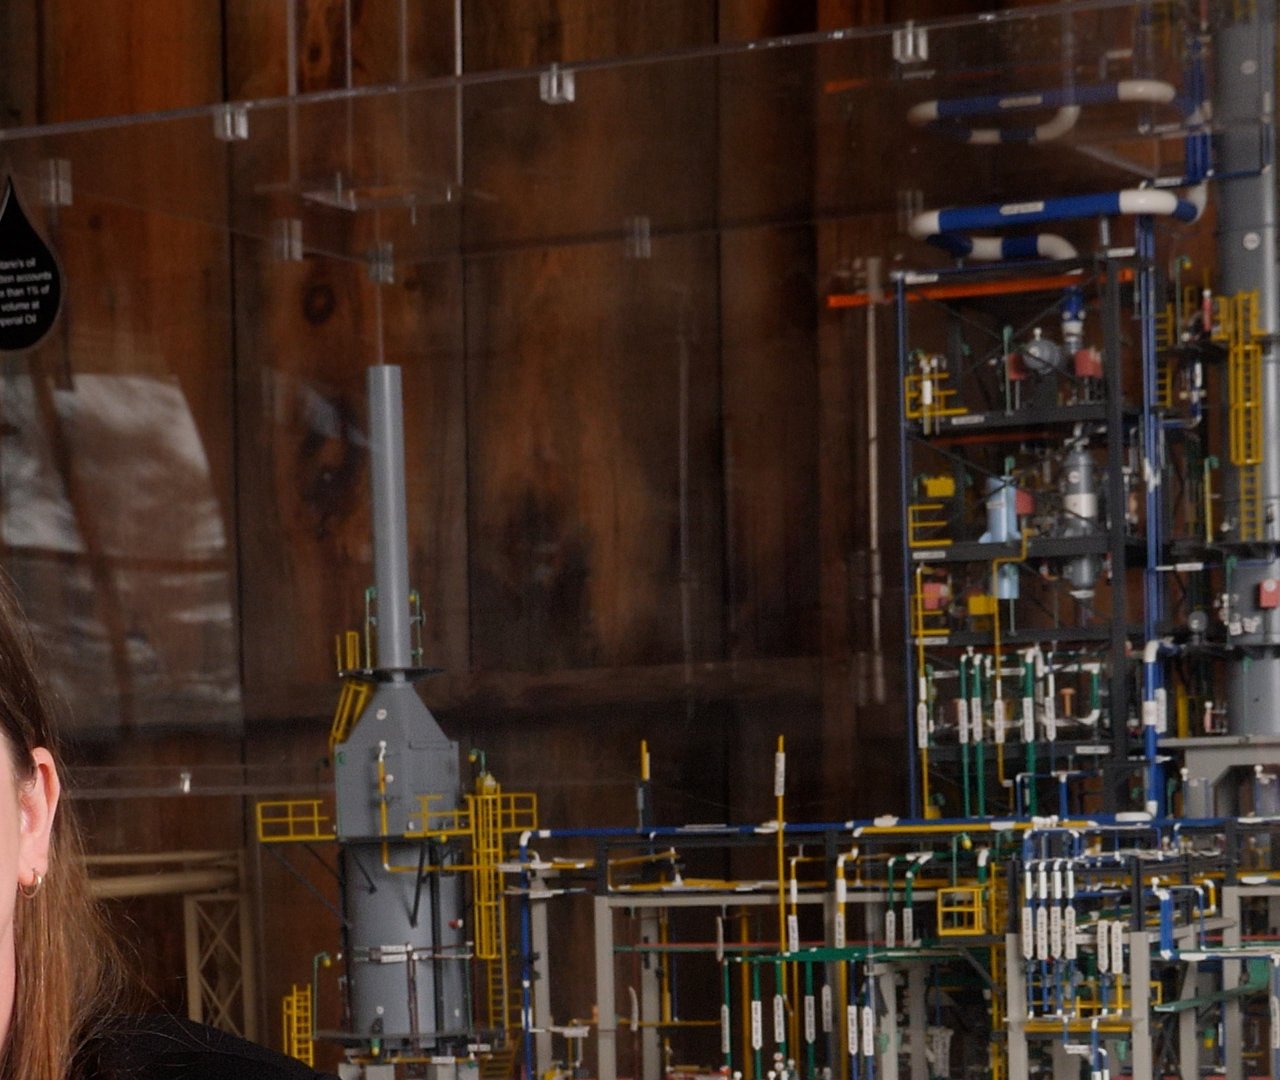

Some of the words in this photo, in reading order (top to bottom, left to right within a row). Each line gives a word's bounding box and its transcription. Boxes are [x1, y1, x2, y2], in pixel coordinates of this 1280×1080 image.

[26, 258, 36, 268] oil
[16, 271, 52, 282] accounts
[7, 288, 24, 298] than
[27, 286, 39, 296] 1%
[40, 285, 50, 295] of
[1, 302, 30, 312] volume
[32, 301, 40, 309] at
[25, 314, 36, 324] Oil
